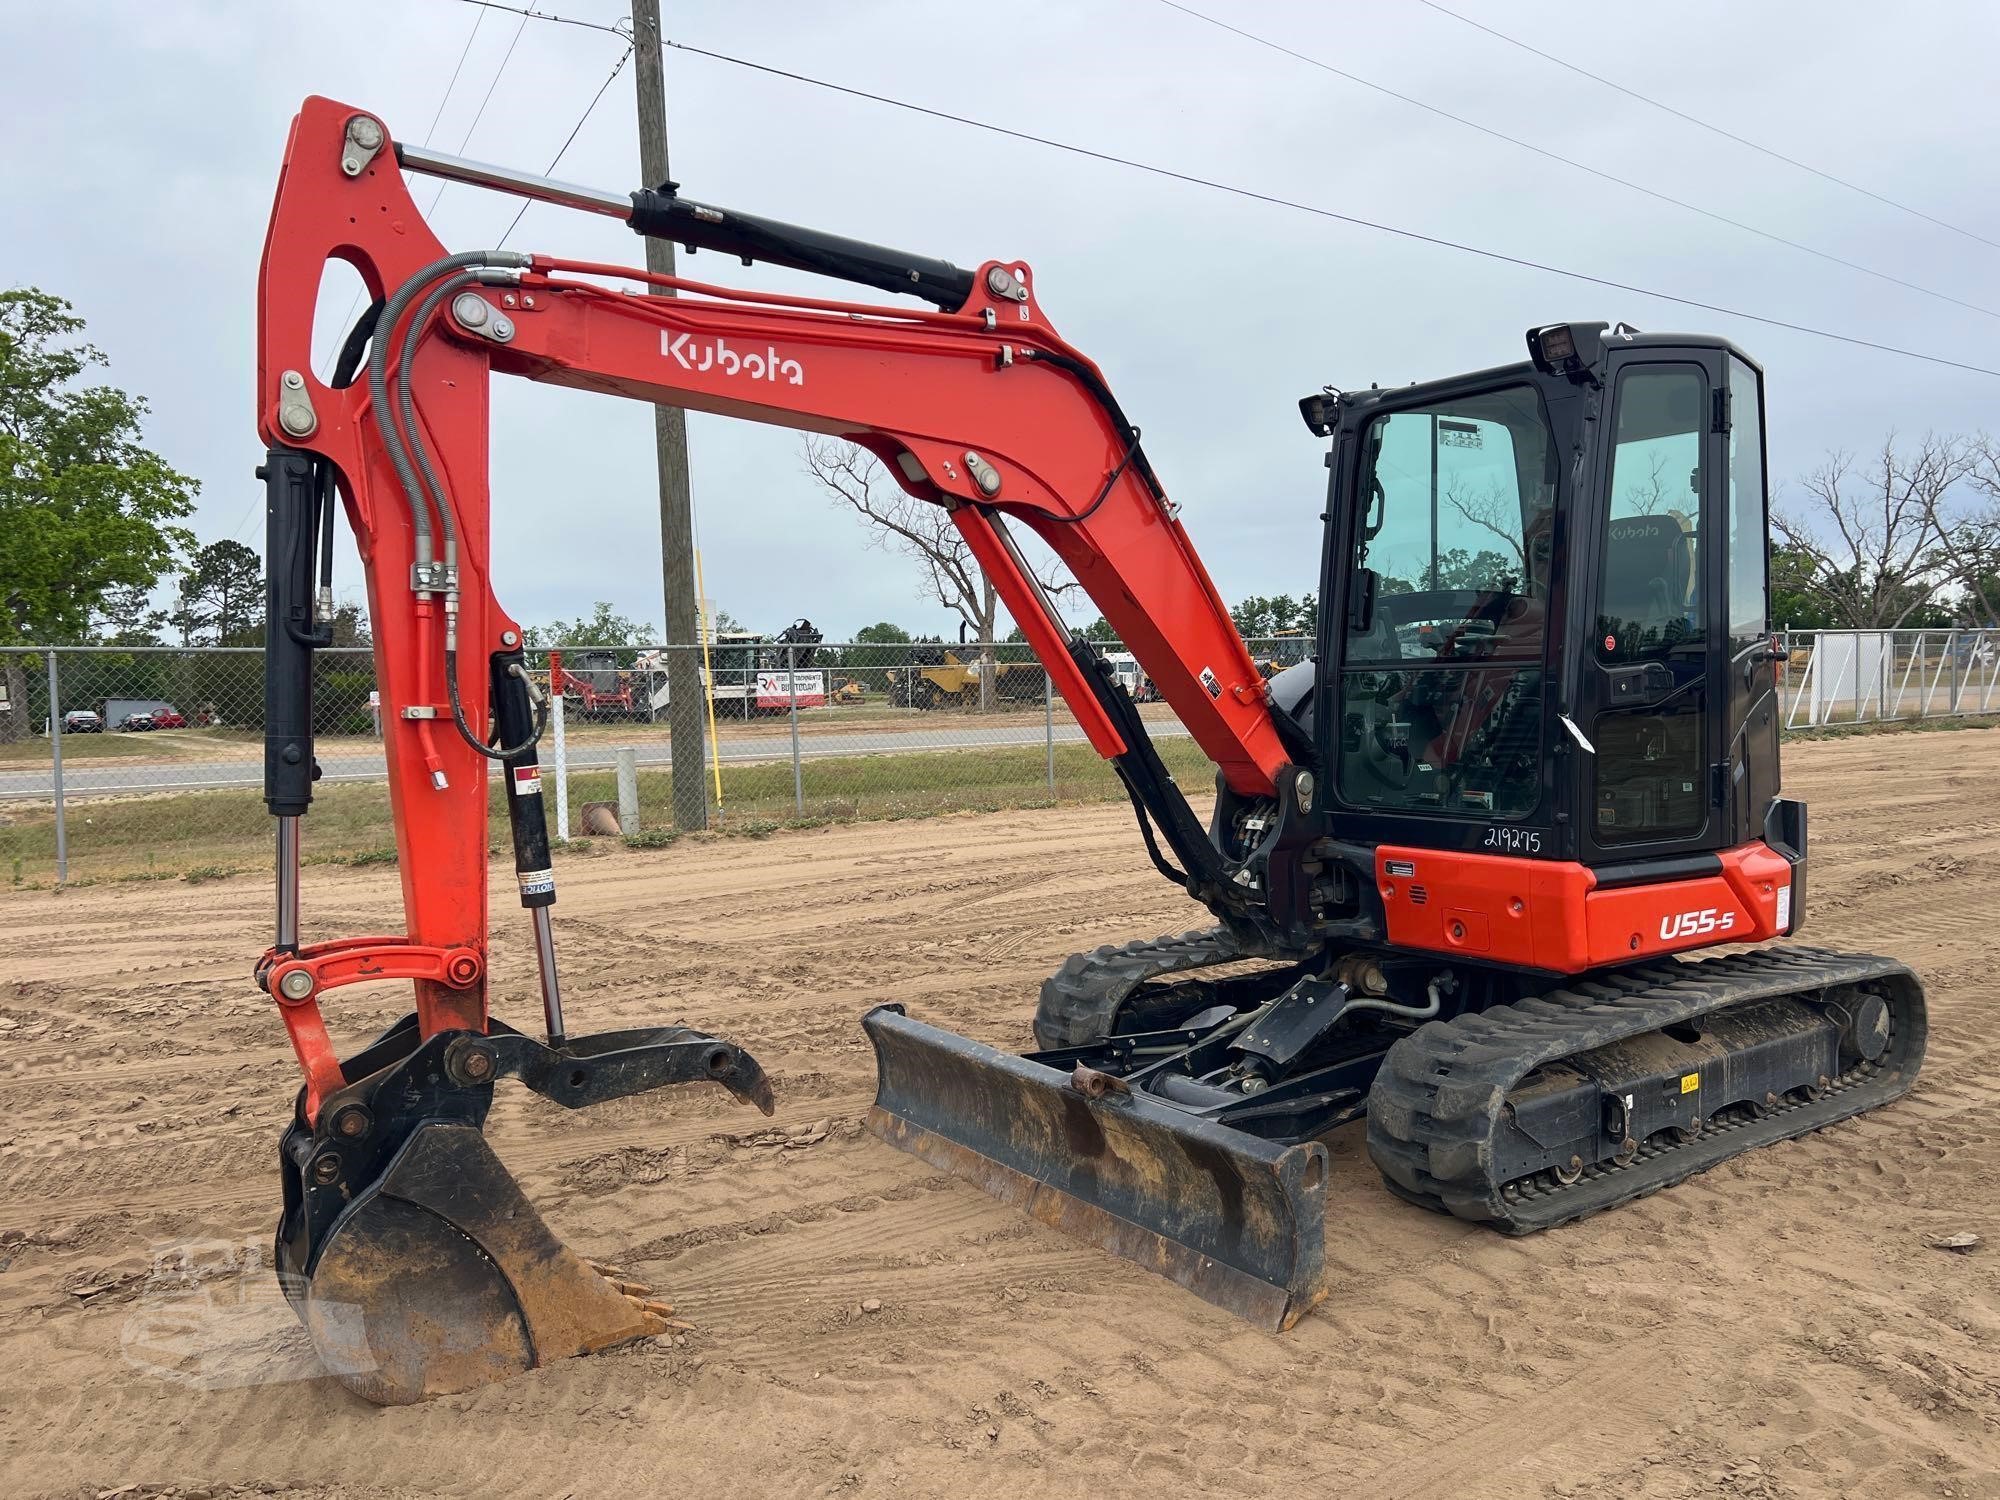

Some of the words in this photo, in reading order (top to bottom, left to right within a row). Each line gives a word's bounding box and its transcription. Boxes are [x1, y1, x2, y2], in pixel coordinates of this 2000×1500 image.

[660, 329, 803, 386] Kubota
[1608, 525, 1659, 540] Kubota
[1484, 827, 1541, 853] 219275
[522, 882, 554, 895] NOTICE
[1659, 908, 1735, 940] U55-5
